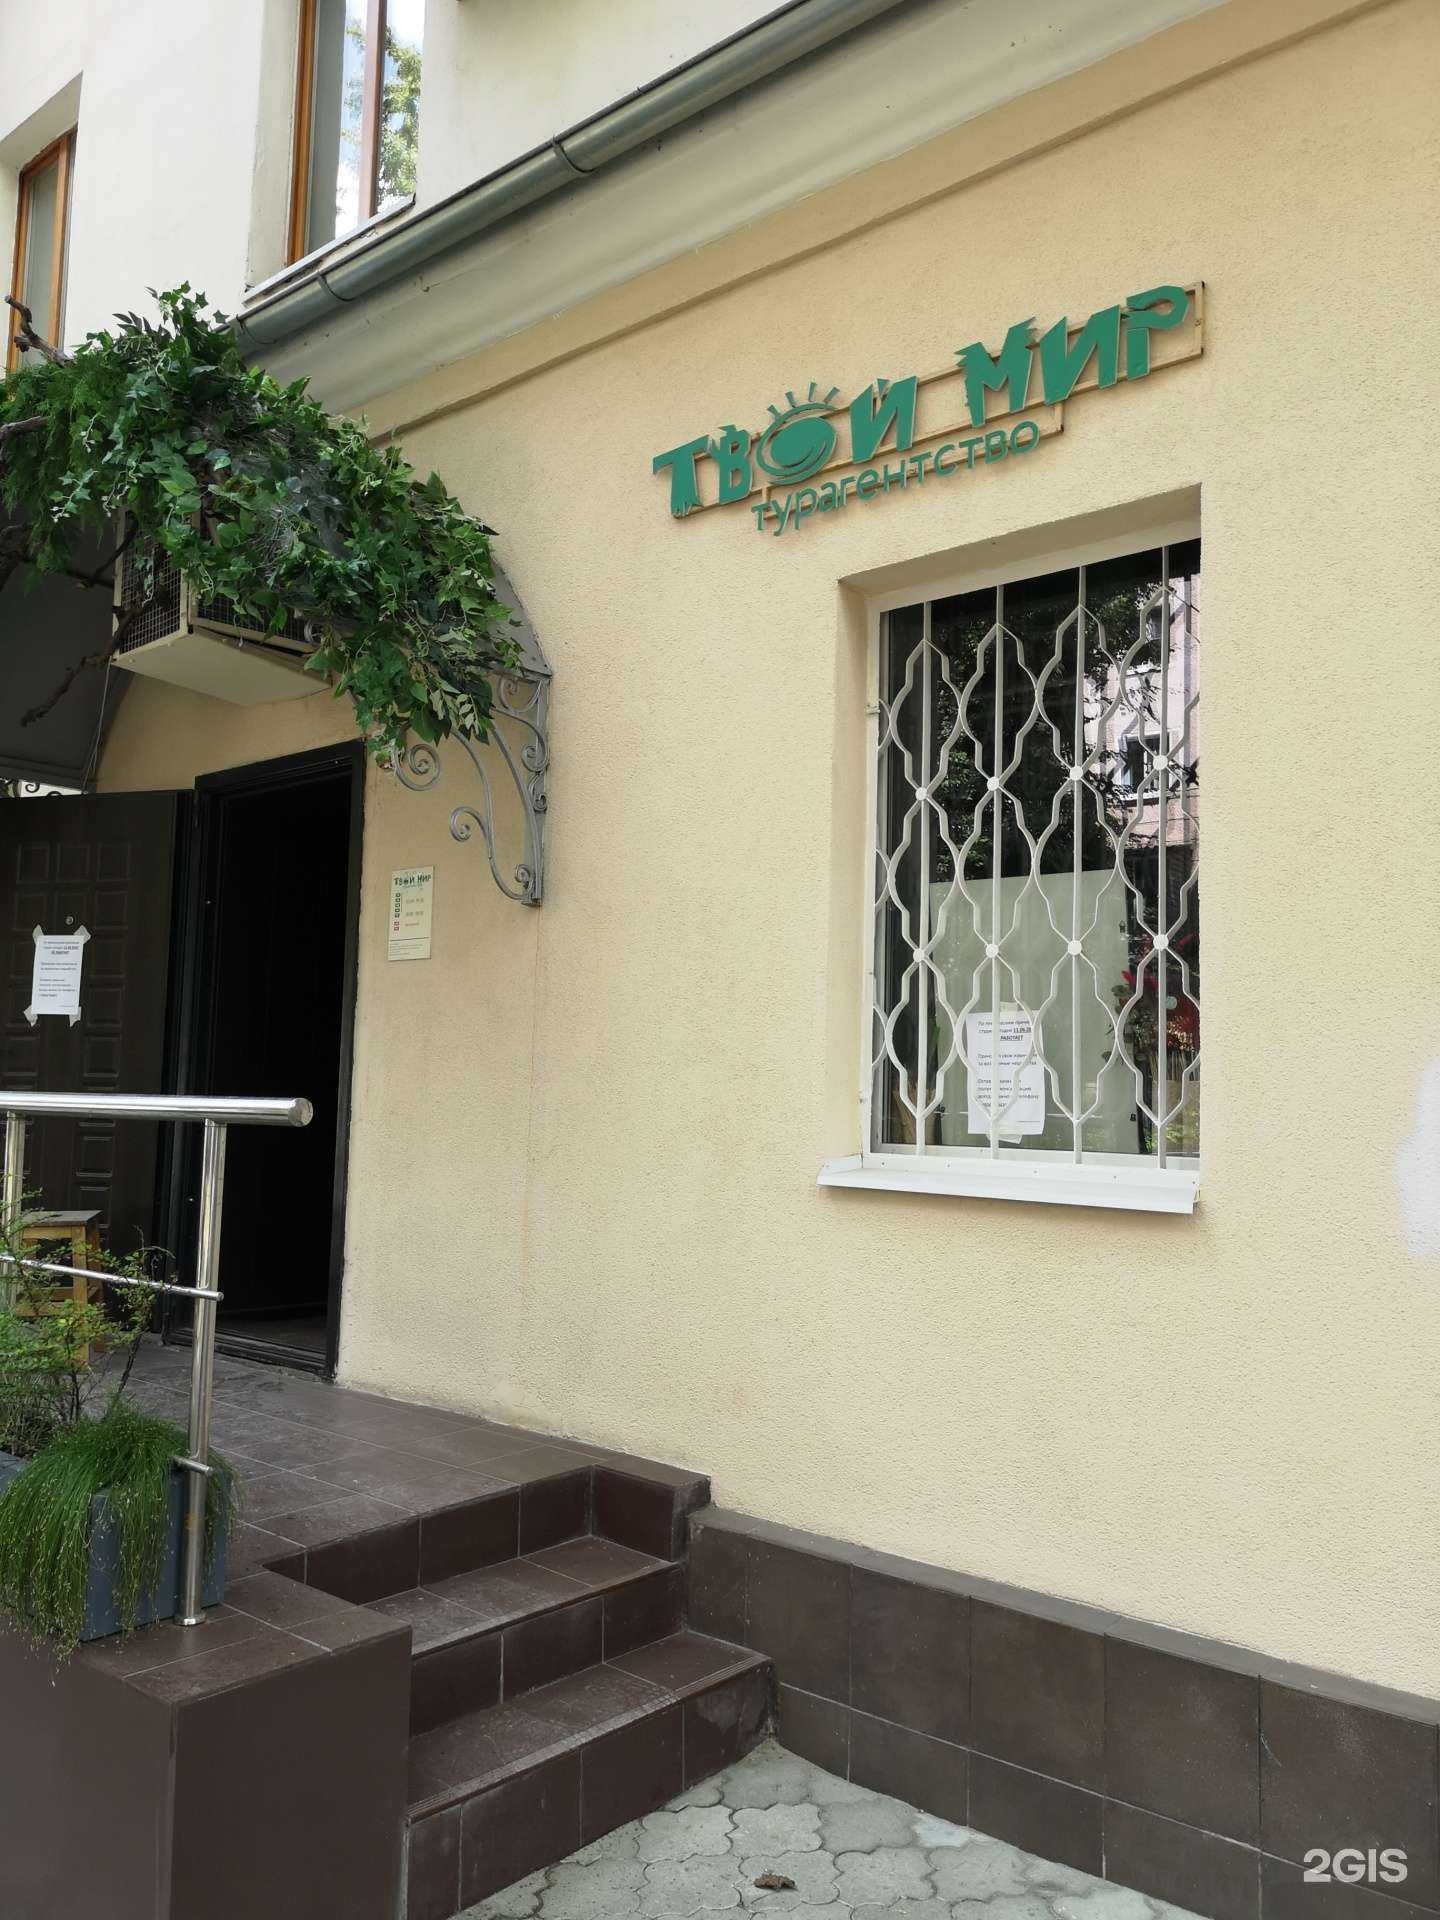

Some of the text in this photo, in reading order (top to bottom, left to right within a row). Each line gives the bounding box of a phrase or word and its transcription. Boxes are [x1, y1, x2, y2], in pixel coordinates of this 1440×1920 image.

[652, 285, 1190, 517] ТВОЙ МИР
[751, 420, 1039, 536] турагентство
